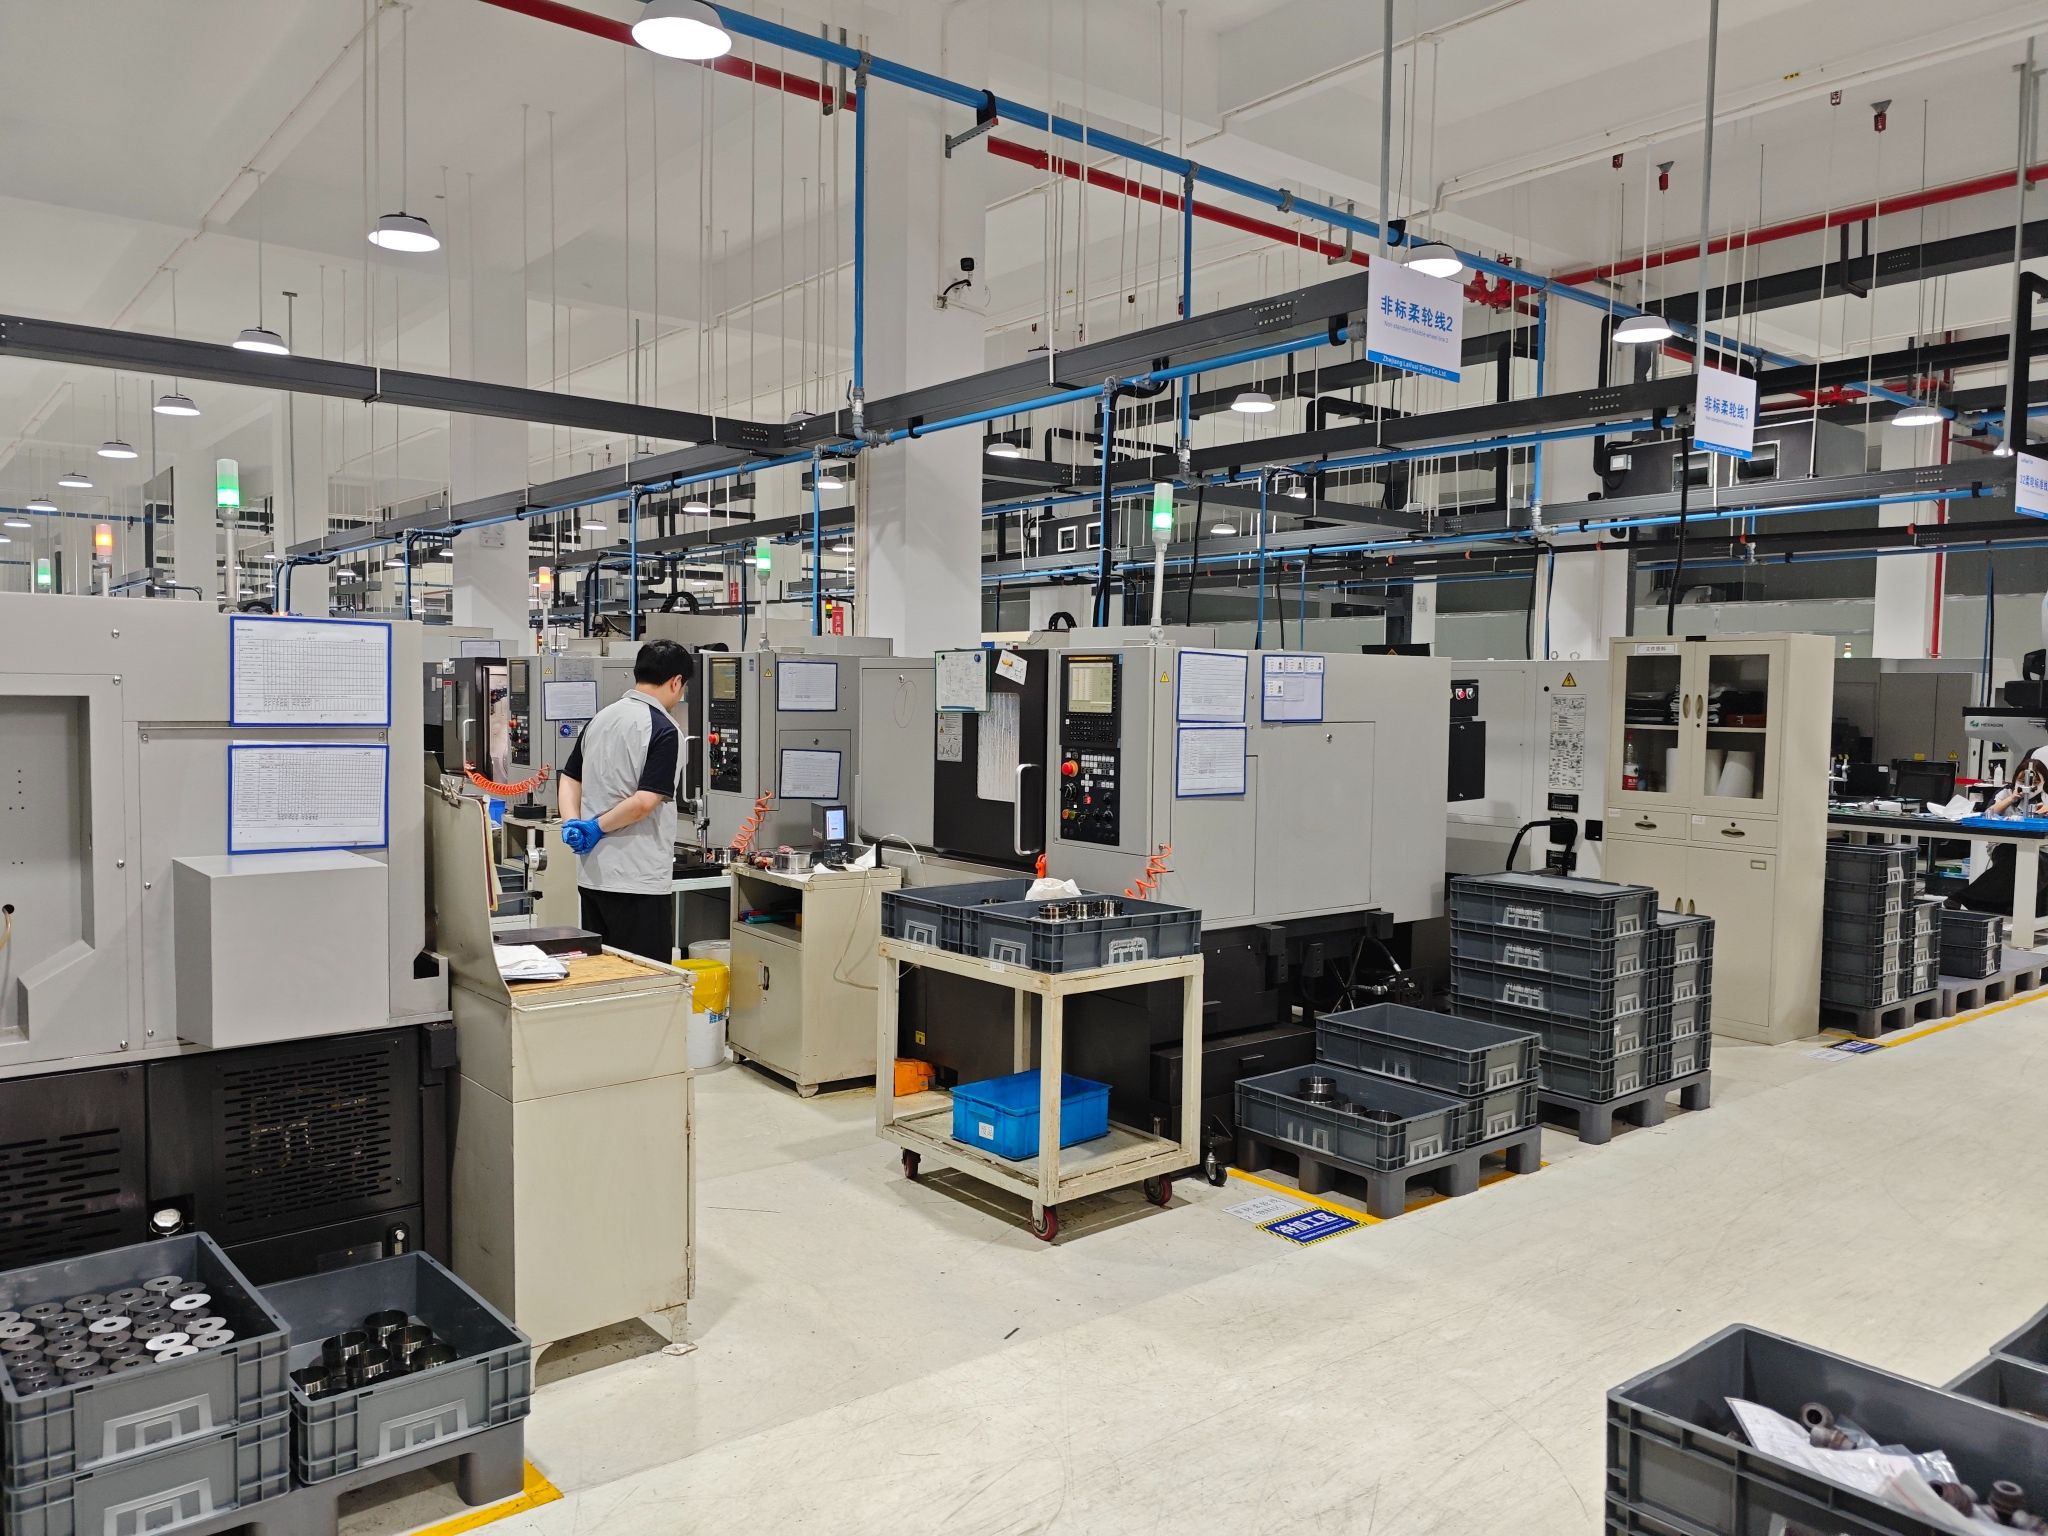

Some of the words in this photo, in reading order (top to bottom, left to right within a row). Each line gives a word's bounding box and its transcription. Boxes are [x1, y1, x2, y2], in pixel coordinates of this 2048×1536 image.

[1381, 296, 1453, 332] 非标柔轮线2
[1704, 396, 1749, 420] 非标柔轮线1
